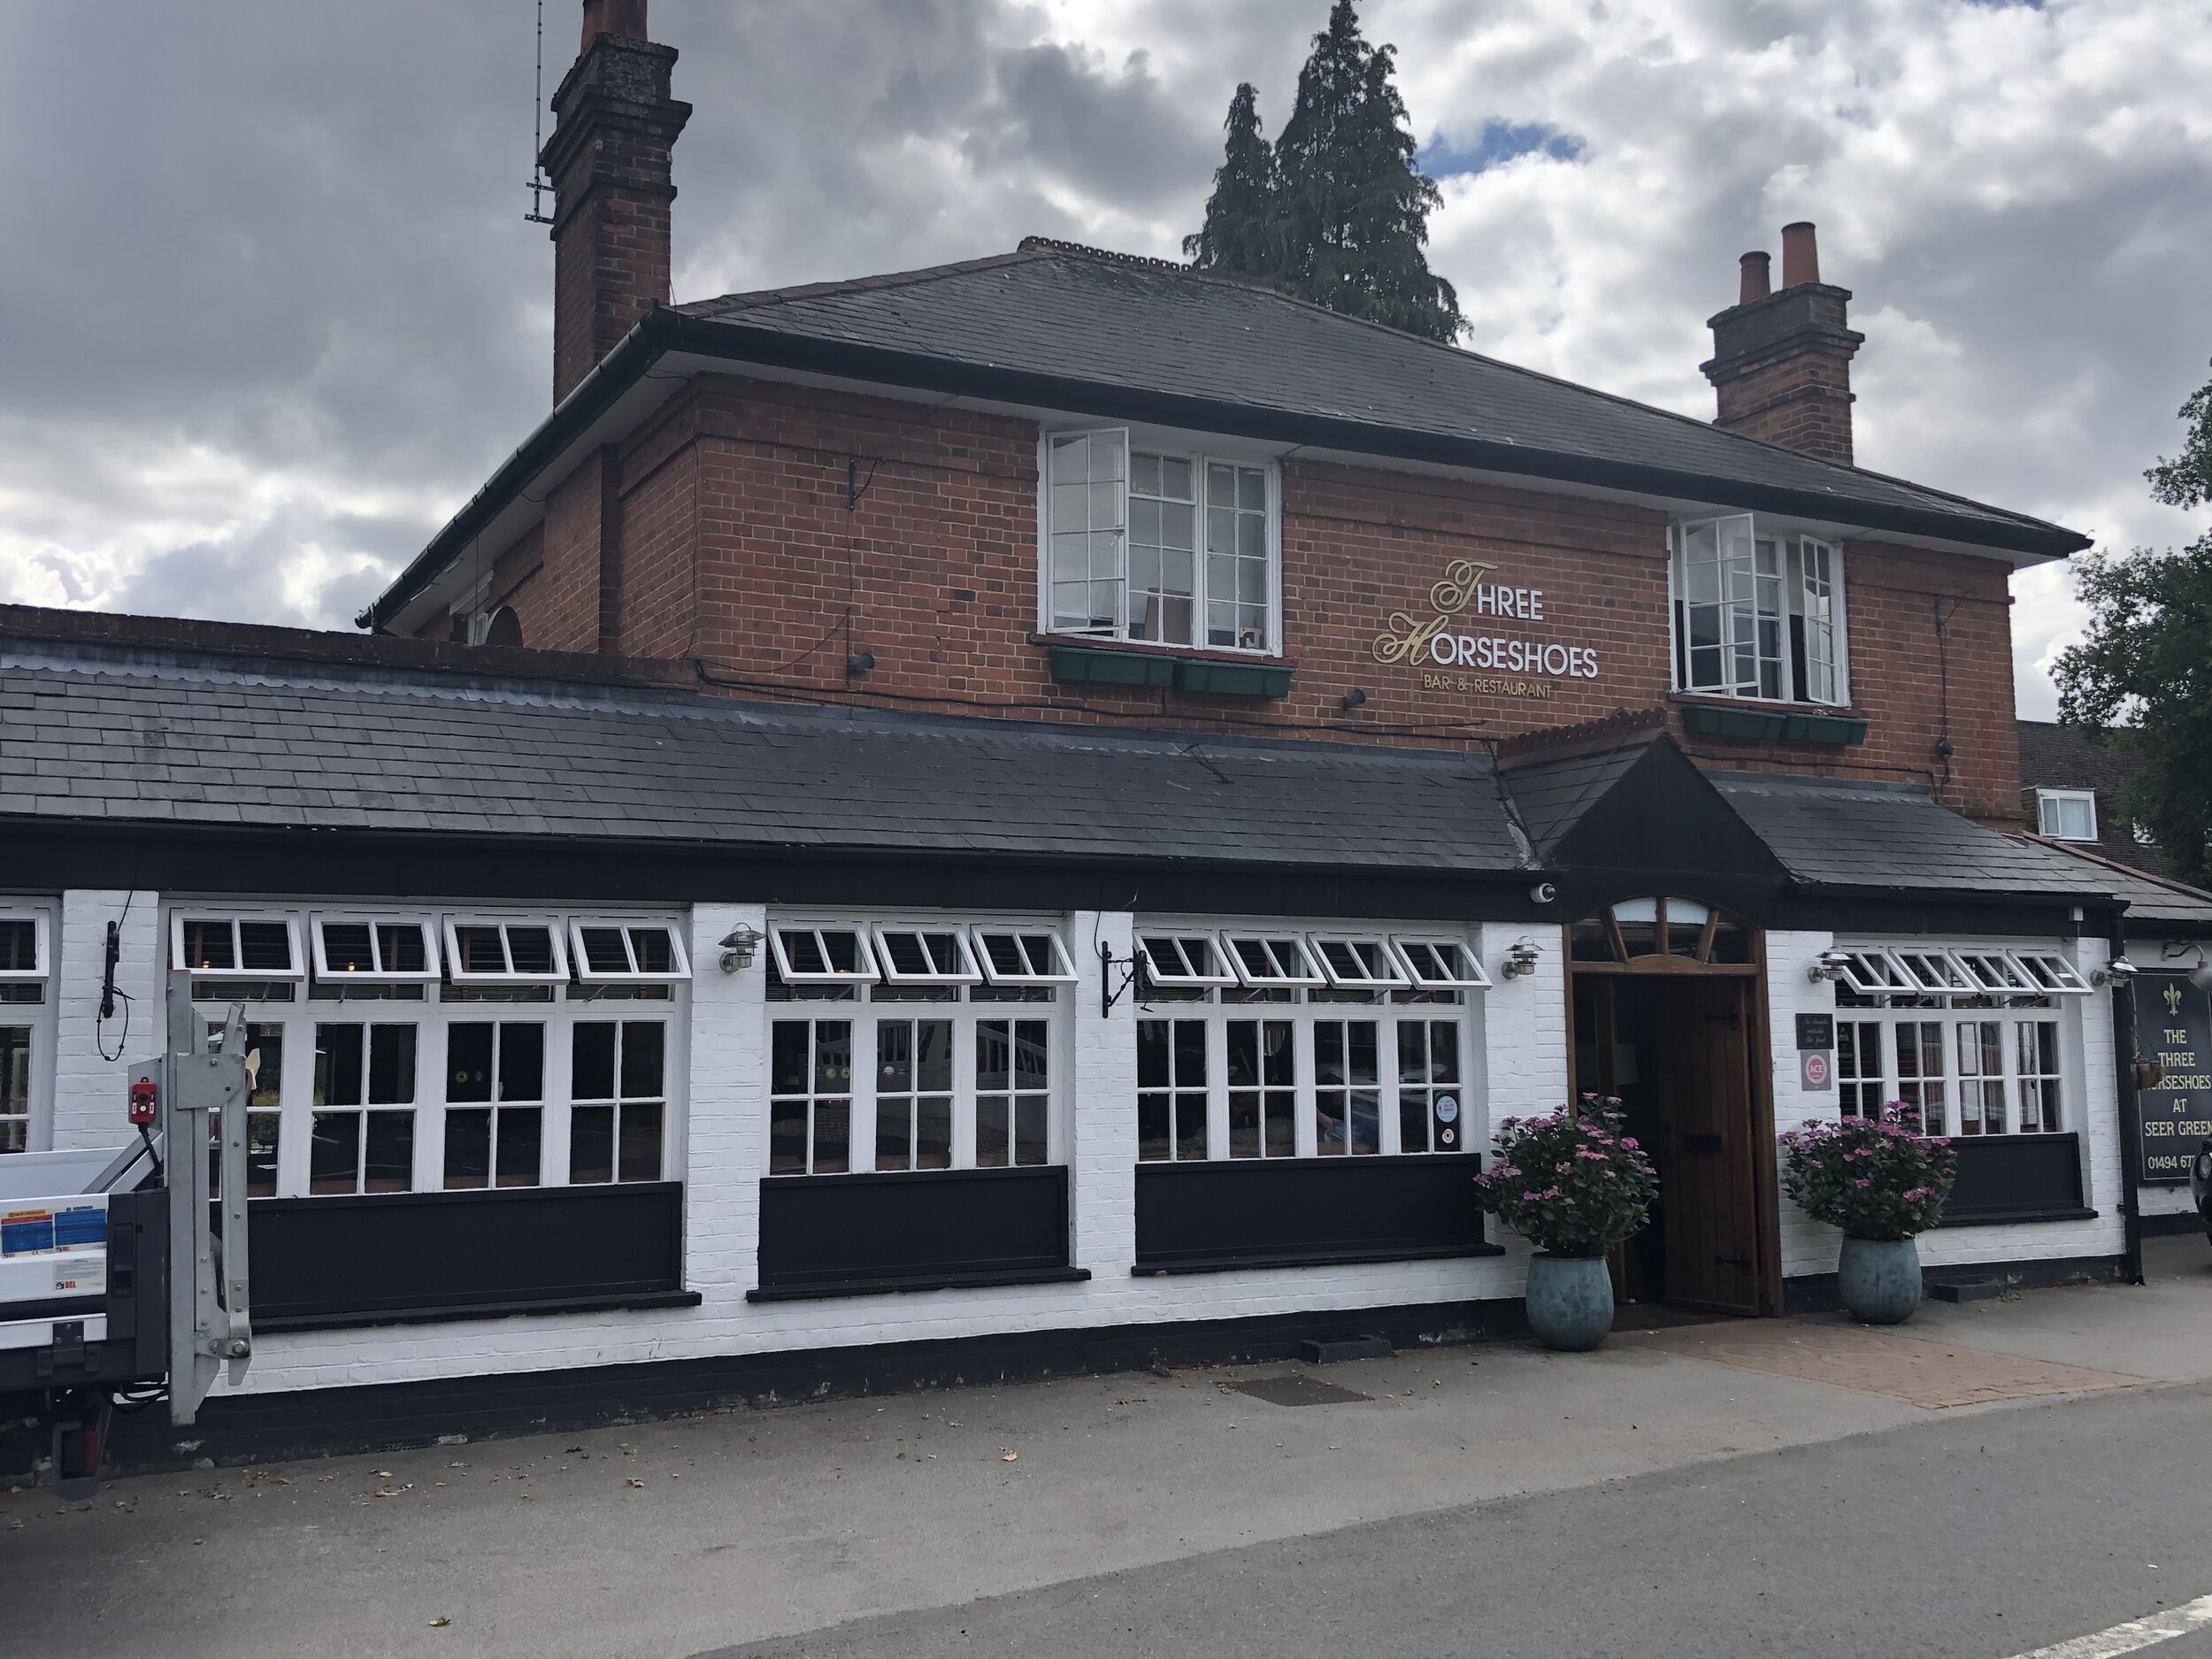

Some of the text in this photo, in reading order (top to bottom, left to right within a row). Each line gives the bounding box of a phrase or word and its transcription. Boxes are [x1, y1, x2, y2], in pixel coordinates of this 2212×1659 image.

[1430, 559, 1544, 620] THREE
[1372, 612, 1598, 679] HORSESHOES
[1424, 674, 1551, 698] BAR & RESTAURANT
[2163, 1029, 2187, 1044] THE
[2157, 1052, 2196, 1067] THREE
[2143, 1074, 2211, 1090] RSESHOES
[2172, 1098, 2187, 1113] AT
[2145, 1121, 2175, 1137] SEER
[2147, 1156, 2177, 1170] 01494
